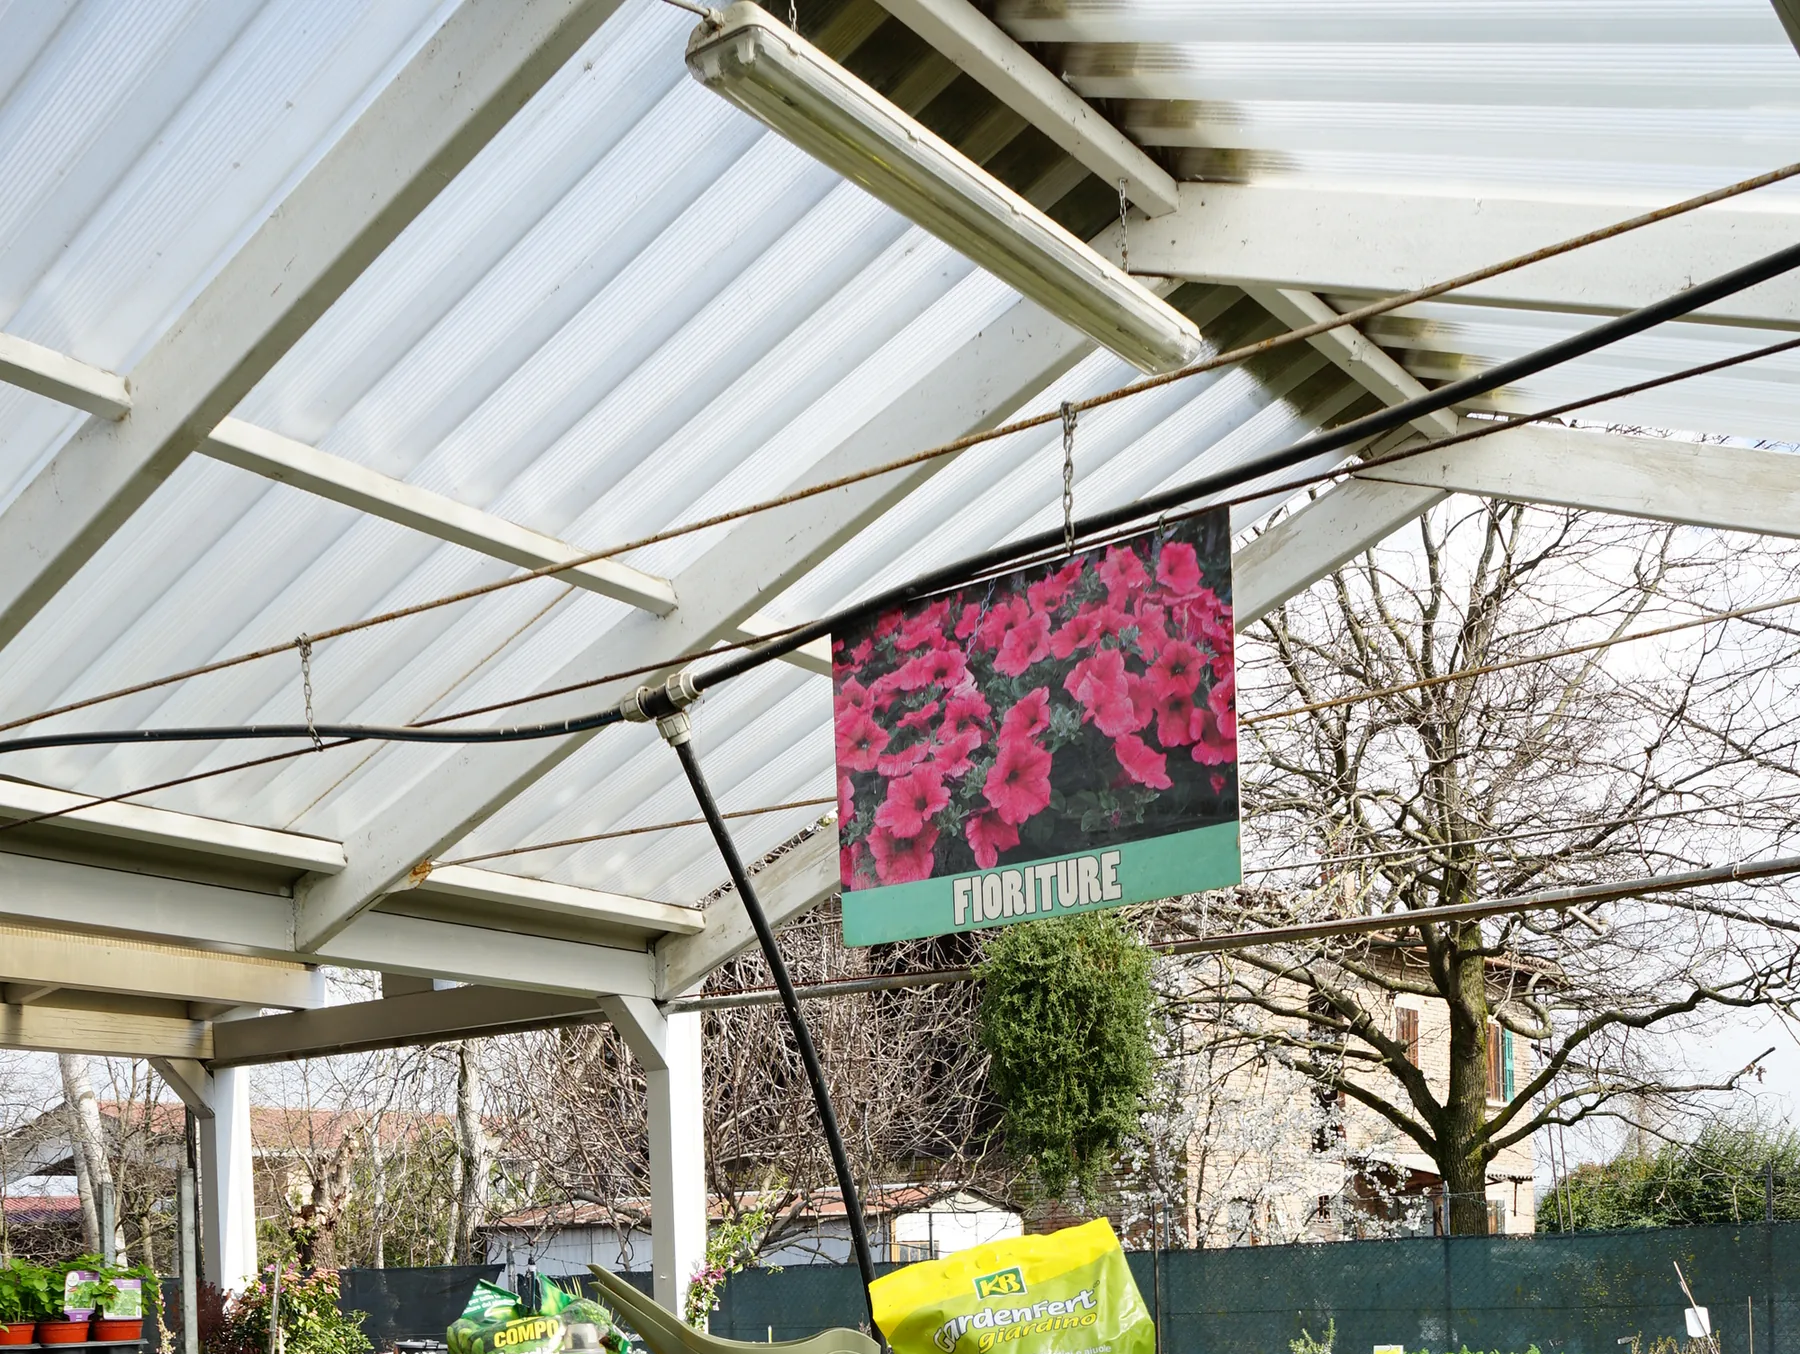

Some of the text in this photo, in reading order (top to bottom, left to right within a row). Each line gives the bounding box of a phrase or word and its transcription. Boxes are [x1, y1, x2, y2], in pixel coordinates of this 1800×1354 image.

[952, 850, 1122, 926] FIORITURE
[980, 1273, 1021, 1297] KB
[493, 1319, 559, 1348] COMPO
[977, 1312, 1098, 1354] giardino
